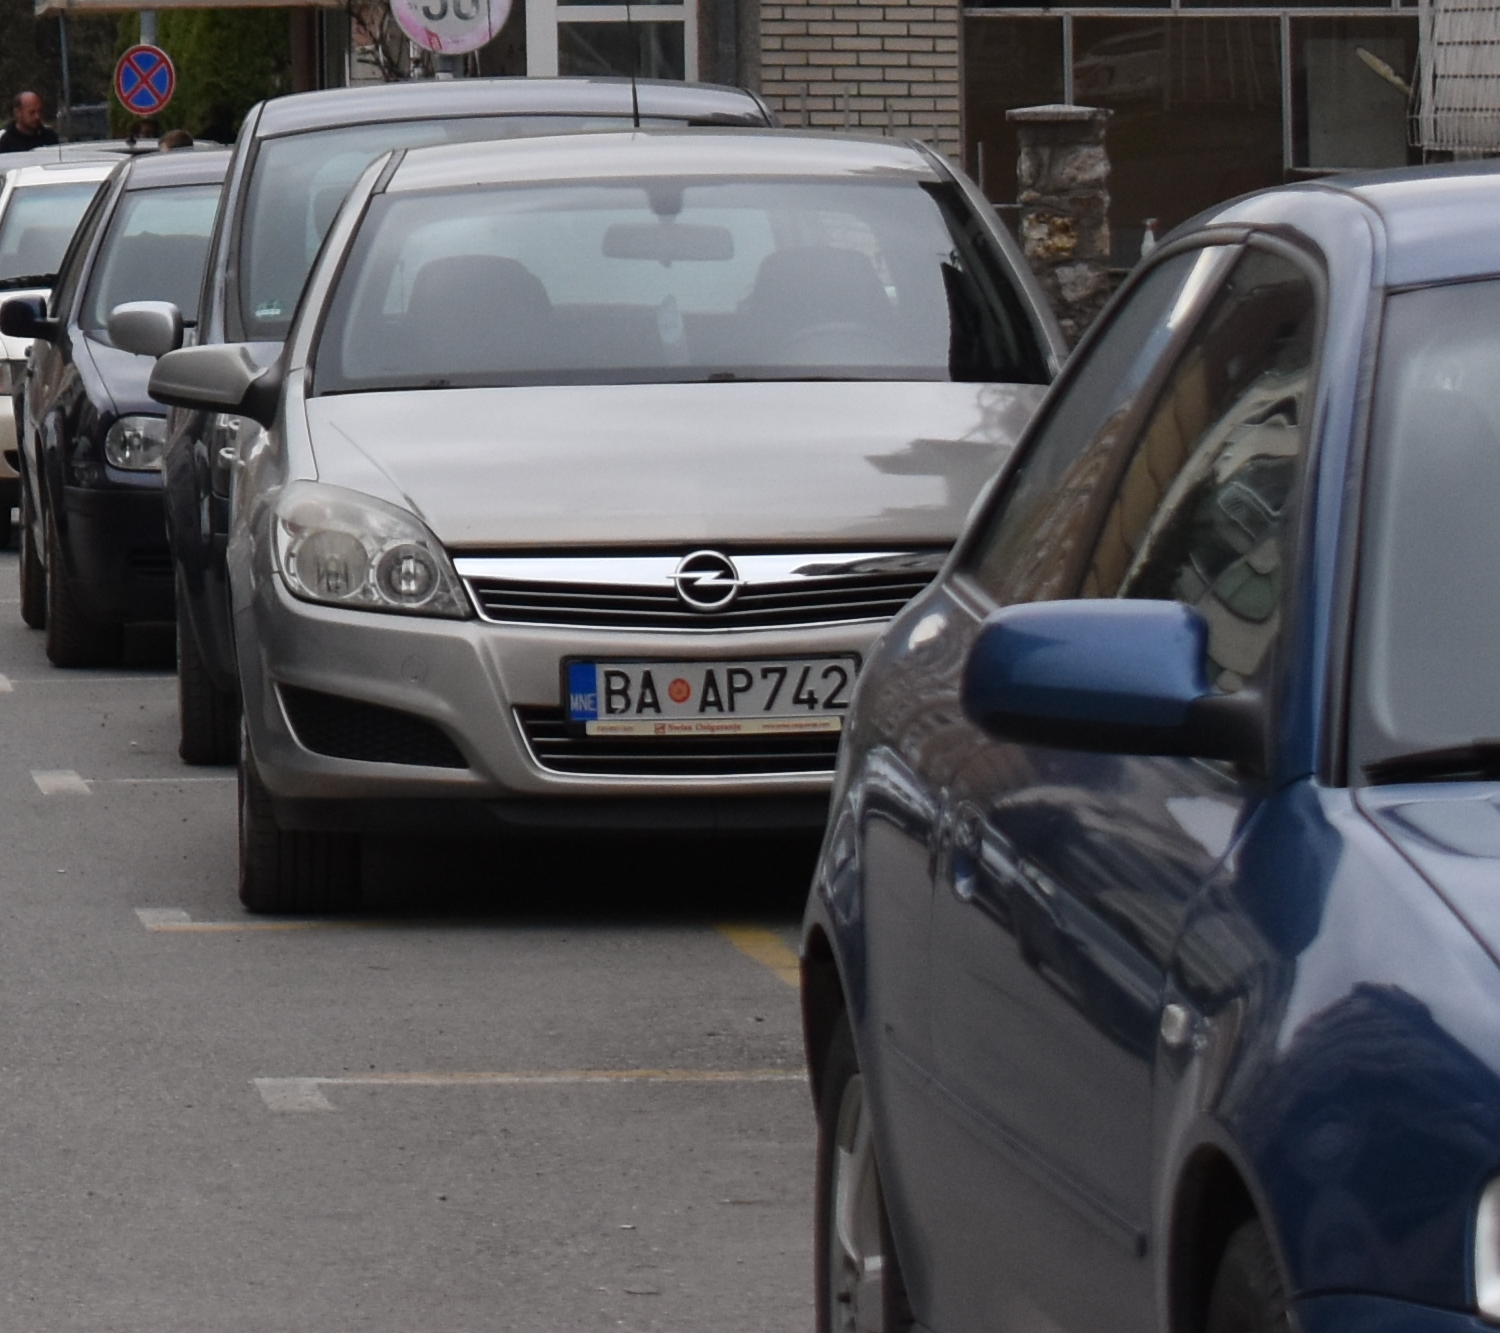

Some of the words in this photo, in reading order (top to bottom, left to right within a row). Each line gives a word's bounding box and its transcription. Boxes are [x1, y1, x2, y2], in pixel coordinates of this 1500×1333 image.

[570, 694, 597, 711] MNE
[603, 669, 662, 714] BA
[700, 665, 849, 713] AP742
